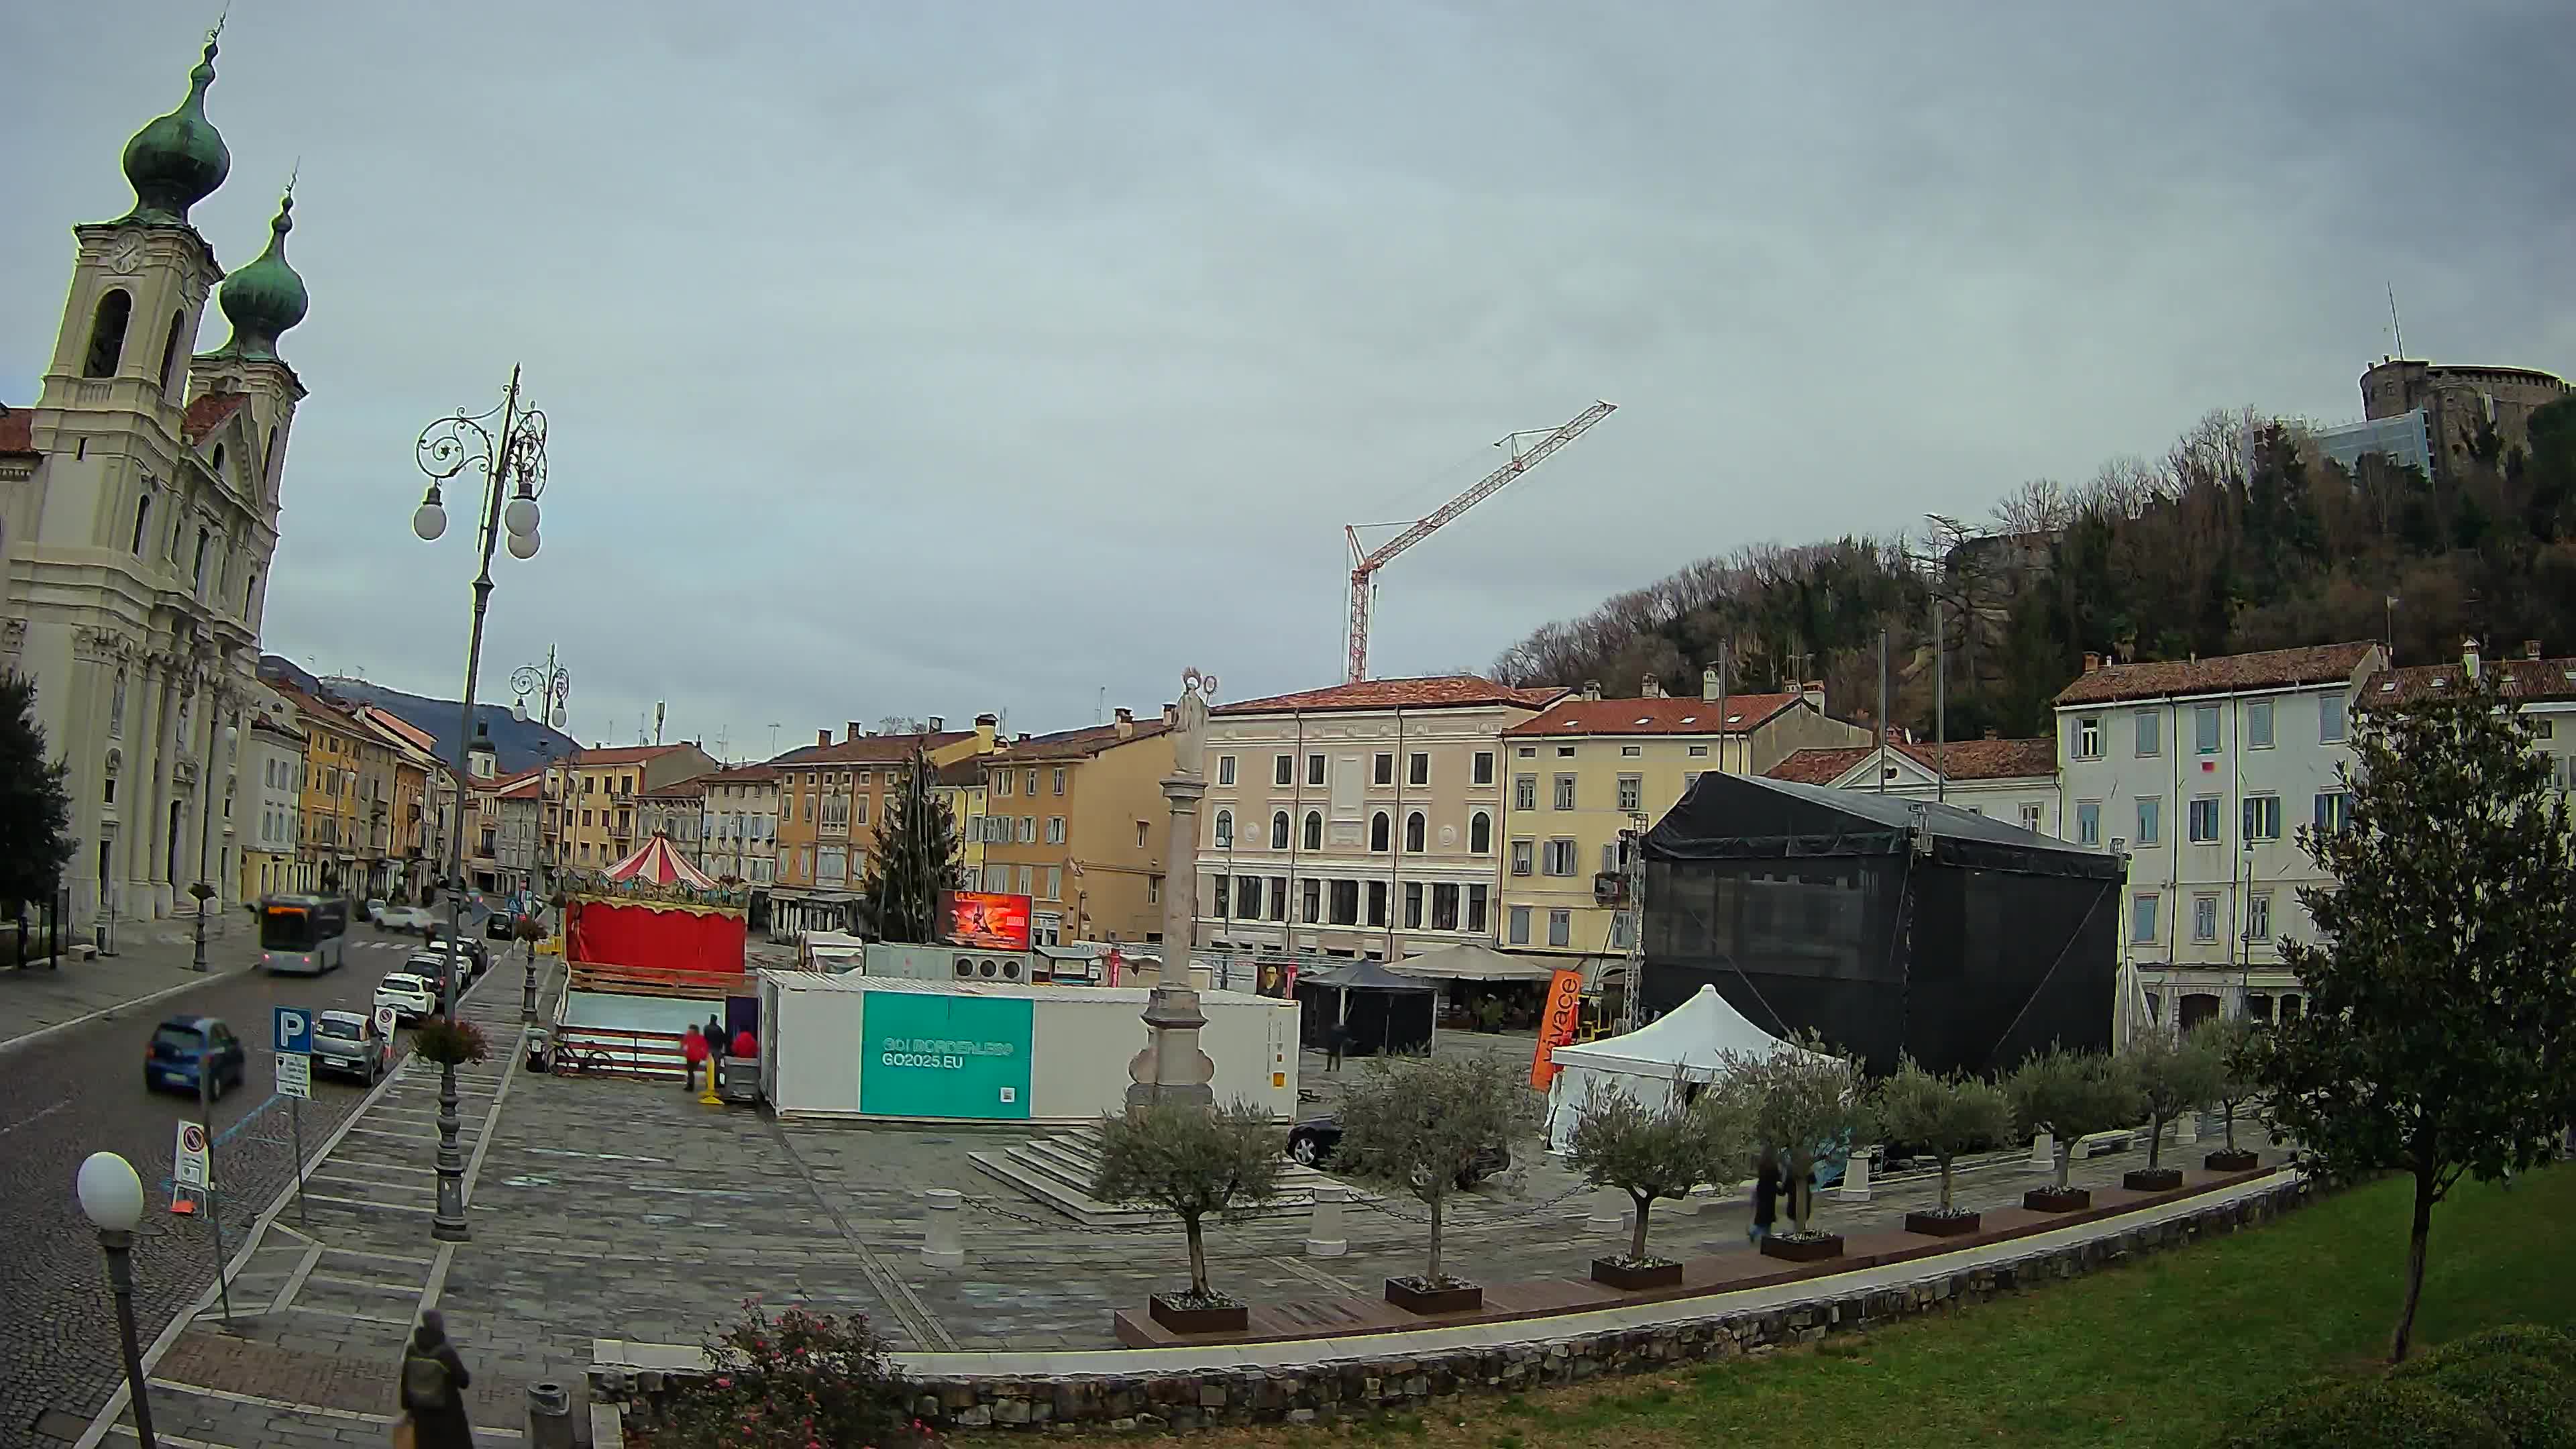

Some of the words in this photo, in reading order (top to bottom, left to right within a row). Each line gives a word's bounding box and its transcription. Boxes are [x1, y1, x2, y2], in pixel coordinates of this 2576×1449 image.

[280, 1012, 305, 1046] P
[913, 1039, 1014, 1057] BORDERLESS
[882, 1053, 964, 1069] GO2025.EU
